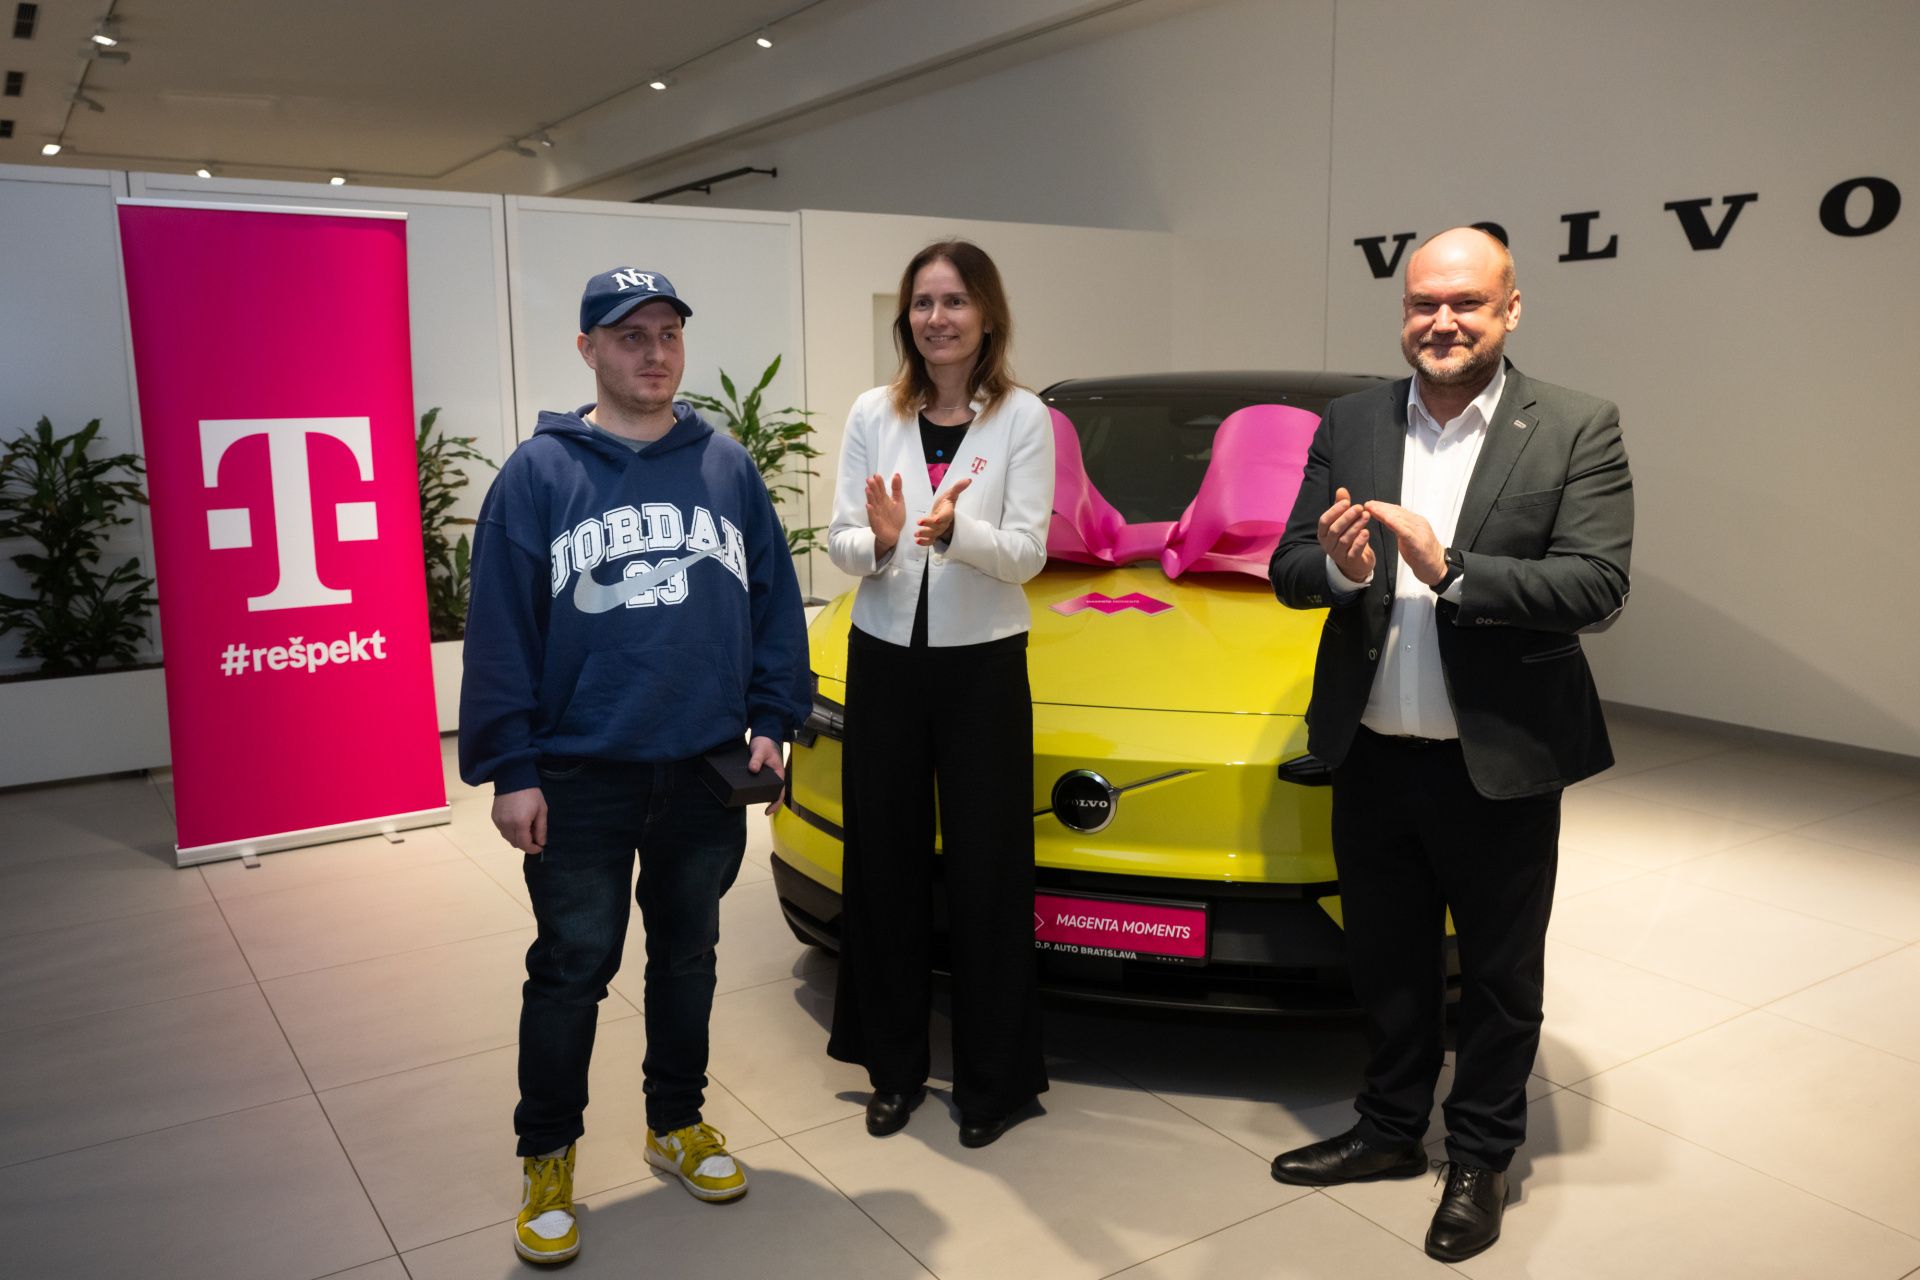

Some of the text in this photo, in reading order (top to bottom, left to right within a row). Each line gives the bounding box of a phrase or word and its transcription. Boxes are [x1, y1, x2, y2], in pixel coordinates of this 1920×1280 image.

[1353, 176, 1902, 280] VLVO
[611, 268, 659, 292] NY
[199, 416, 379, 612] T
[551, 502, 749, 599] JORDAN
[220, 629, 387, 677] #rešpekt
[1056, 913, 1191, 940] MAGENTA MOMENTS
[1053, 943, 1079, 954] AUTO
[1081, 946, 1137, 960] BRATISLAVA
